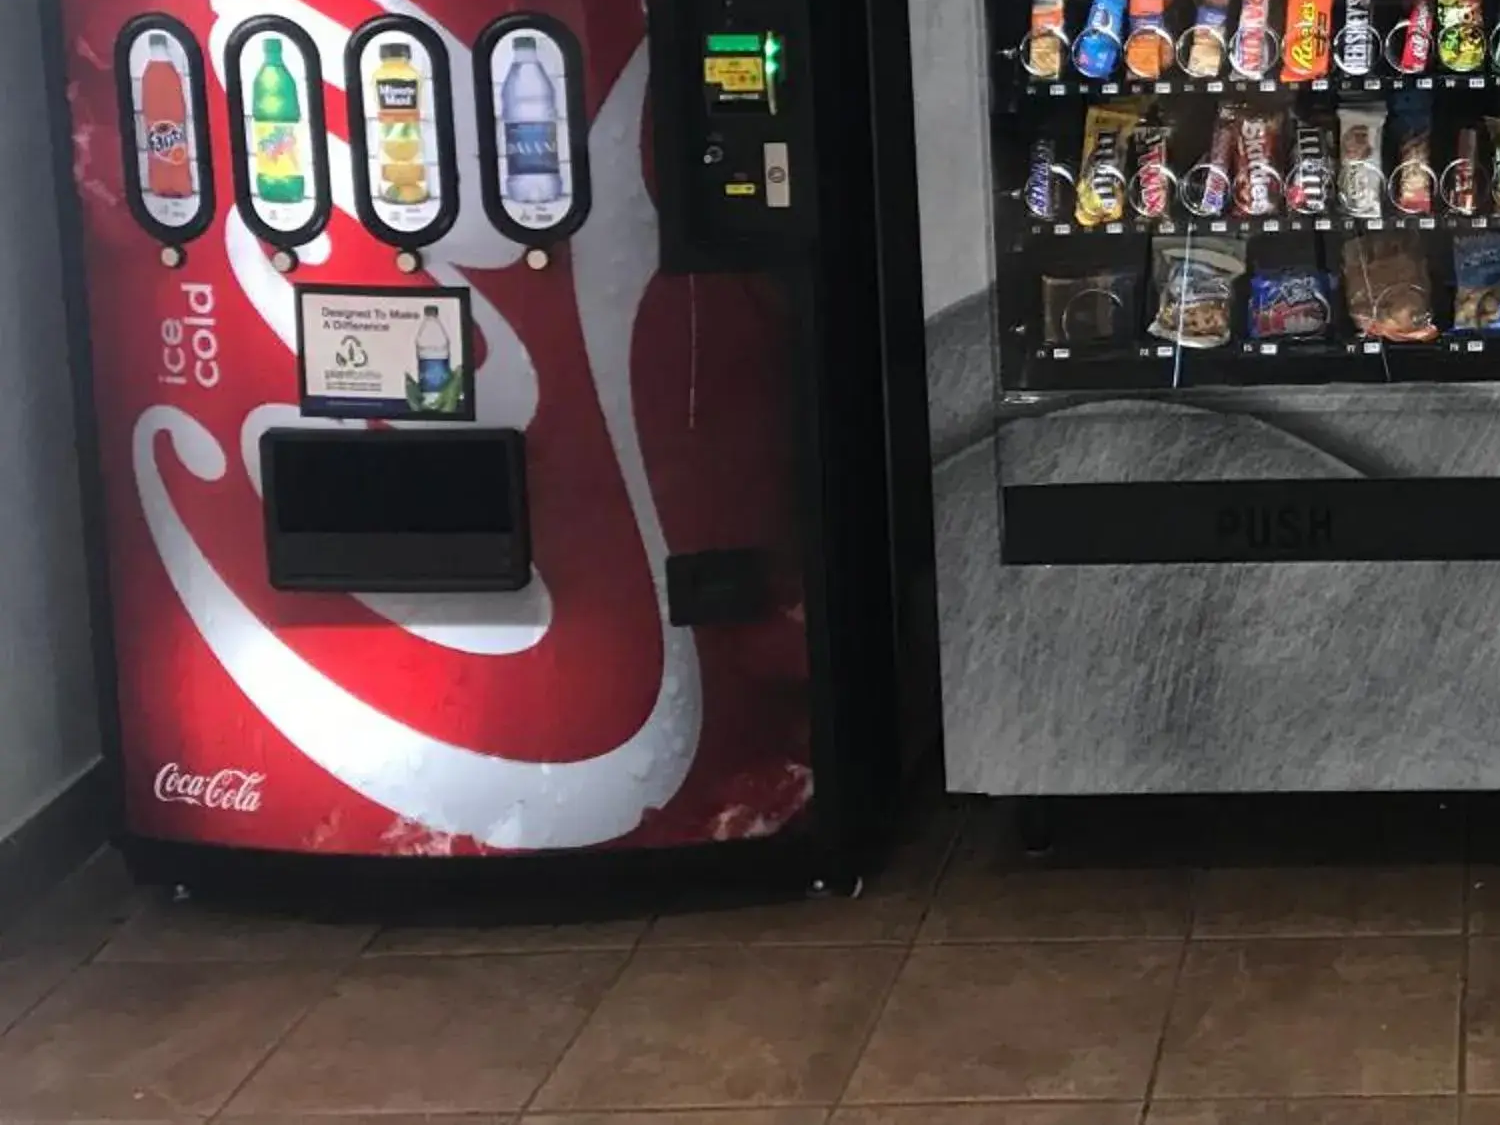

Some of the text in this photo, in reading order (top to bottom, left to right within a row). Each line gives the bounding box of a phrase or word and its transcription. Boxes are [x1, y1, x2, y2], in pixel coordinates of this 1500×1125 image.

[181, 282, 220, 388] cold
[321, 306, 420, 321] Designed To Make
[323, 320, 390, 332] A Difference
[159, 317, 187, 385] ice
[1216, 505, 1332, 550] PUSH
[154, 762, 267, 812] Coca-Cola
